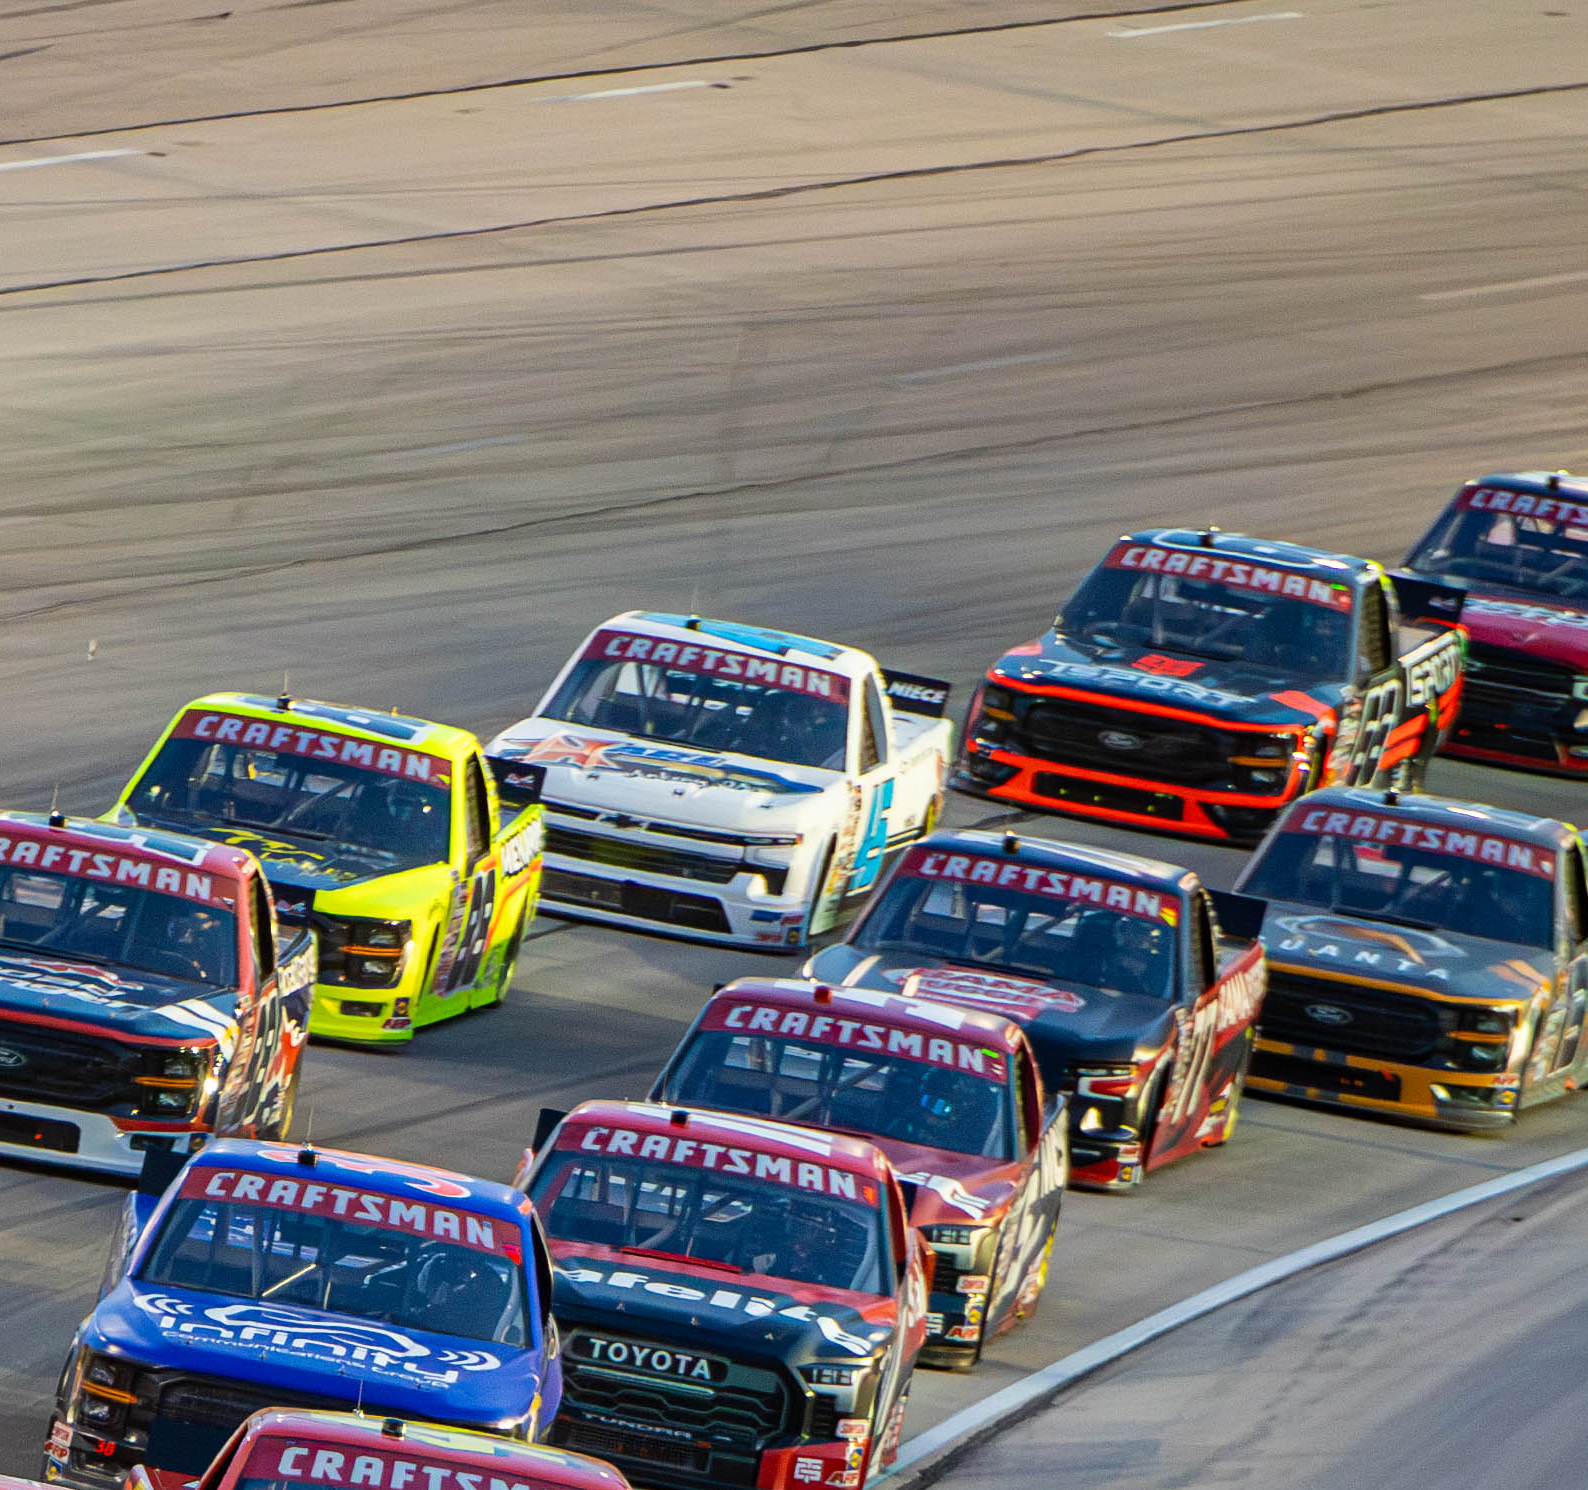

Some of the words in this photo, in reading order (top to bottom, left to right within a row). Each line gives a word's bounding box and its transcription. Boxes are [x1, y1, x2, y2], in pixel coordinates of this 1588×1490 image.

[1119, 547, 1333, 606] CRAFTSMAN
[604, 635, 832, 698] CRAFTSMAN
[194, 713, 432, 783] CRAFTSMAN
[1301, 810, 1535, 871] CRAFTSMAN
[919, 852, 1162, 919] CRAFTSMAN
[724, 1004, 985, 1075] CRAFTSMAN
[580, 1126, 858, 1200] CRAFTSMAN
[205, 1172, 495, 1249] CRAFTSMAN
[553, 1266, 873, 1356] afelite
[589, 1337, 711, 1381] TOYOTA
